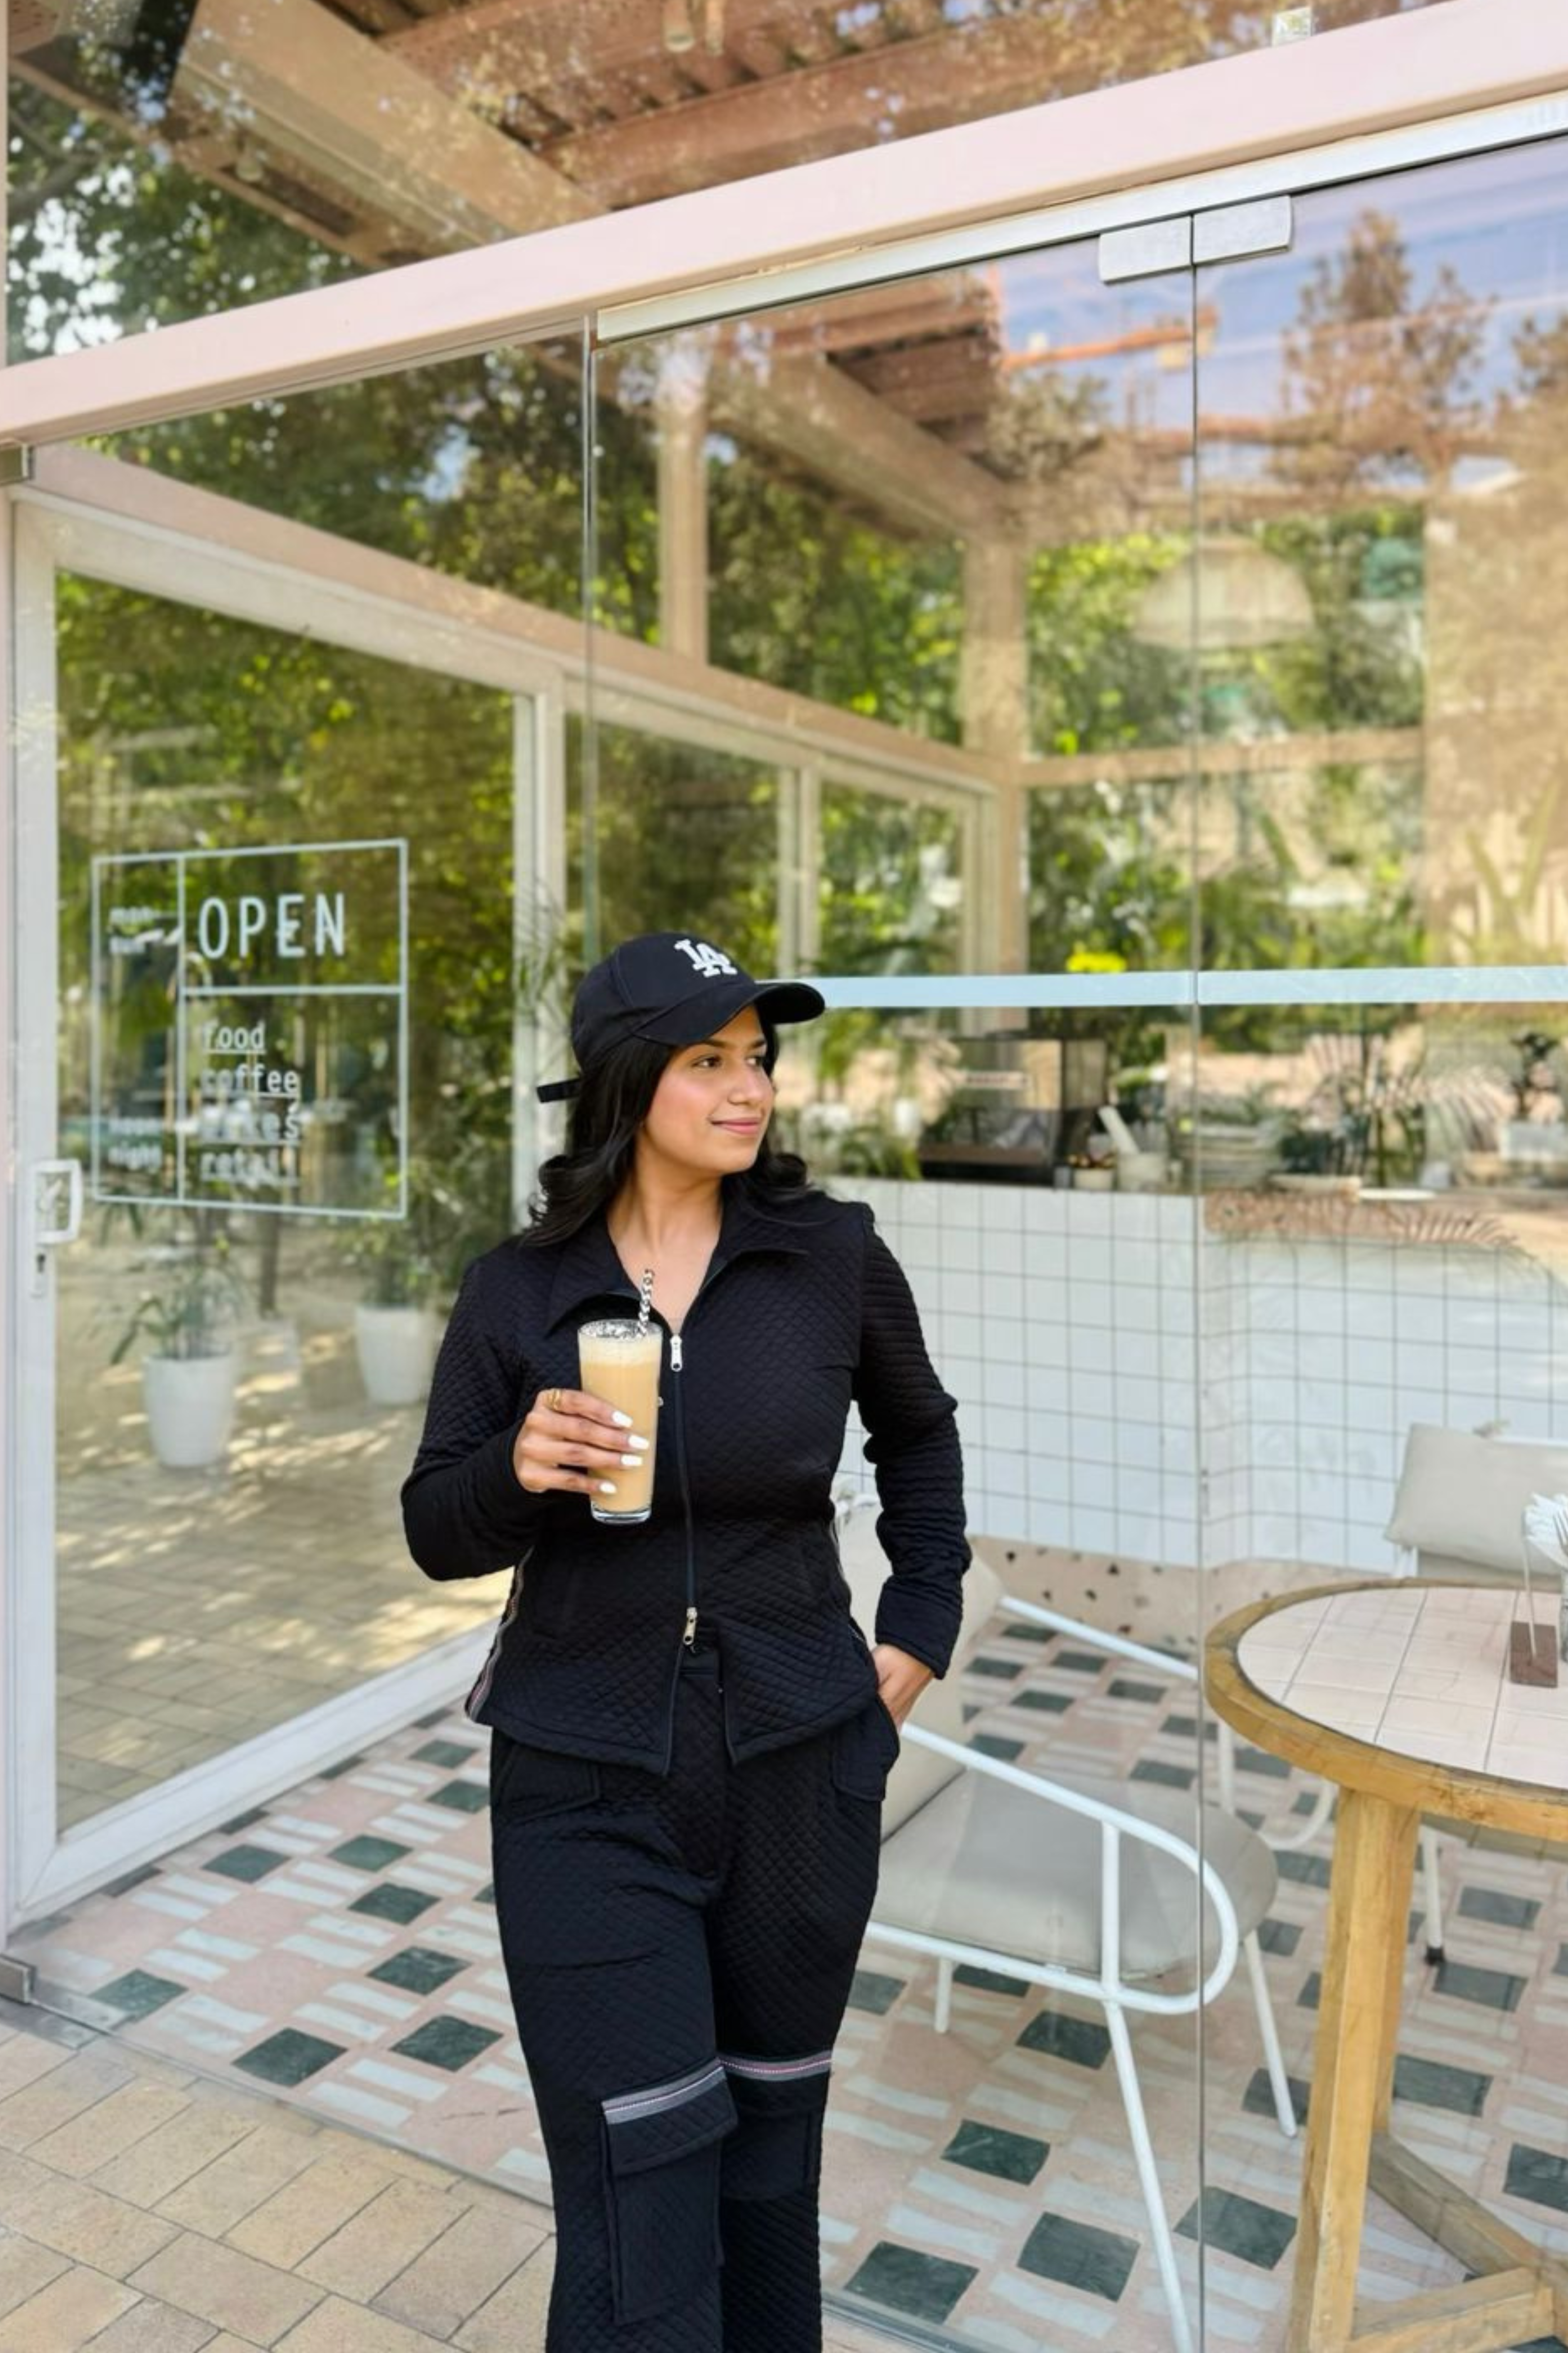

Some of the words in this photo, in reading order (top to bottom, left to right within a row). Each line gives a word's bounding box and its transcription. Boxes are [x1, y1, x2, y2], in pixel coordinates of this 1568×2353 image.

[199, 892, 344, 959] OPEN
[674, 939, 737, 977] LA
[202, 1020, 266, 1050] food
[202, 1064, 299, 1093] coffee
